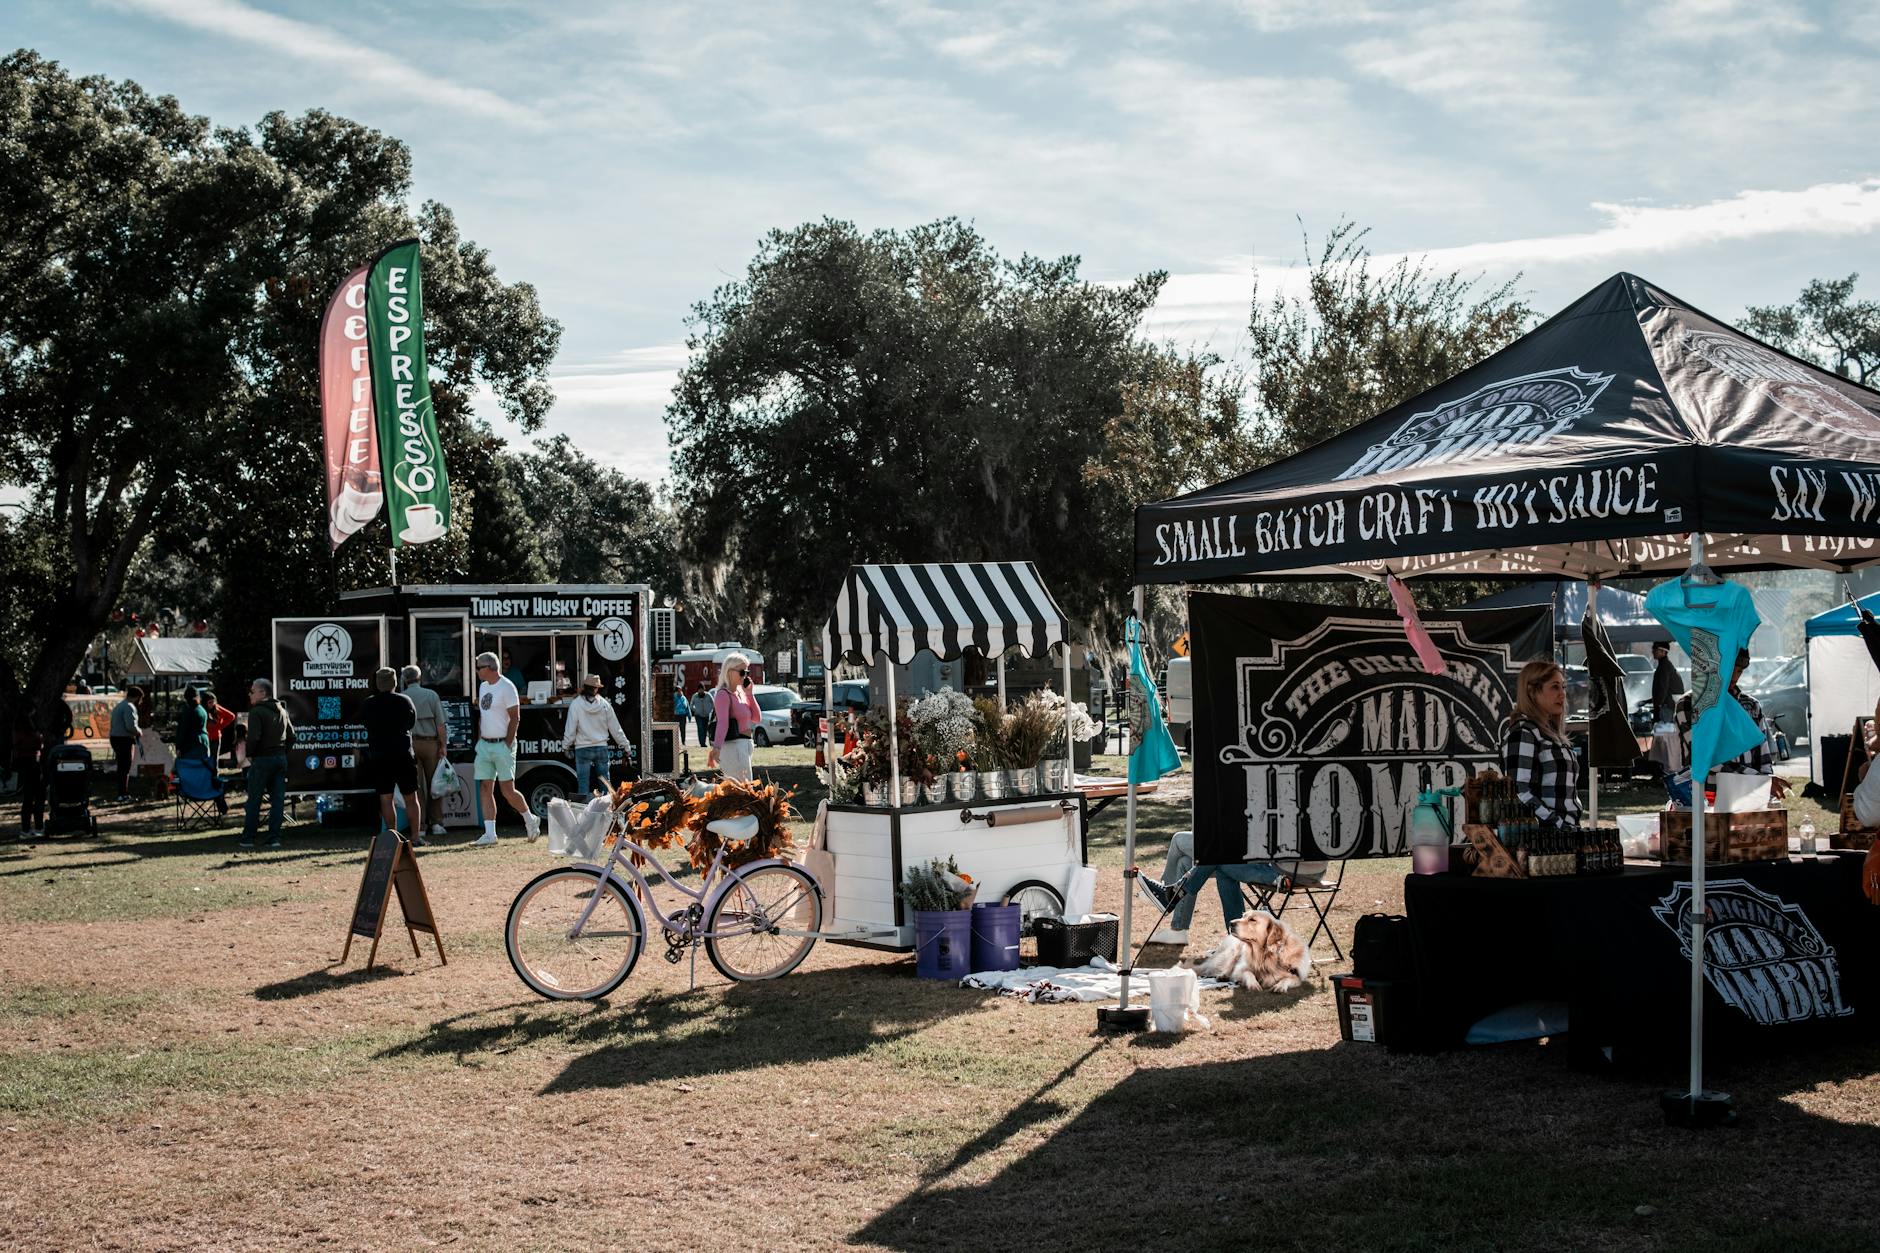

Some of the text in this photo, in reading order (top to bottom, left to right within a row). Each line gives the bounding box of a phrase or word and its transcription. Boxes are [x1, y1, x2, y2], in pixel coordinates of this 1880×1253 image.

[344, 283, 371, 464] COFFEE
[388, 267, 435, 493] ESPRESSO
[1153, 462, 1660, 566] SMALL BATCH CRAFT HOT SAUCE
[1770, 465, 1880, 523] SAY W
[470, 596, 632, 616] THIRSTY HUSKY COFFEE
[290, 678, 369, 690] FOLLOW THE PACK
[1285, 661, 1351, 719] THE
[295, 731, 369, 742] 07-920-8110
[519, 738, 565, 754] THE PAC
[1361, 690, 1450, 753] MAD
